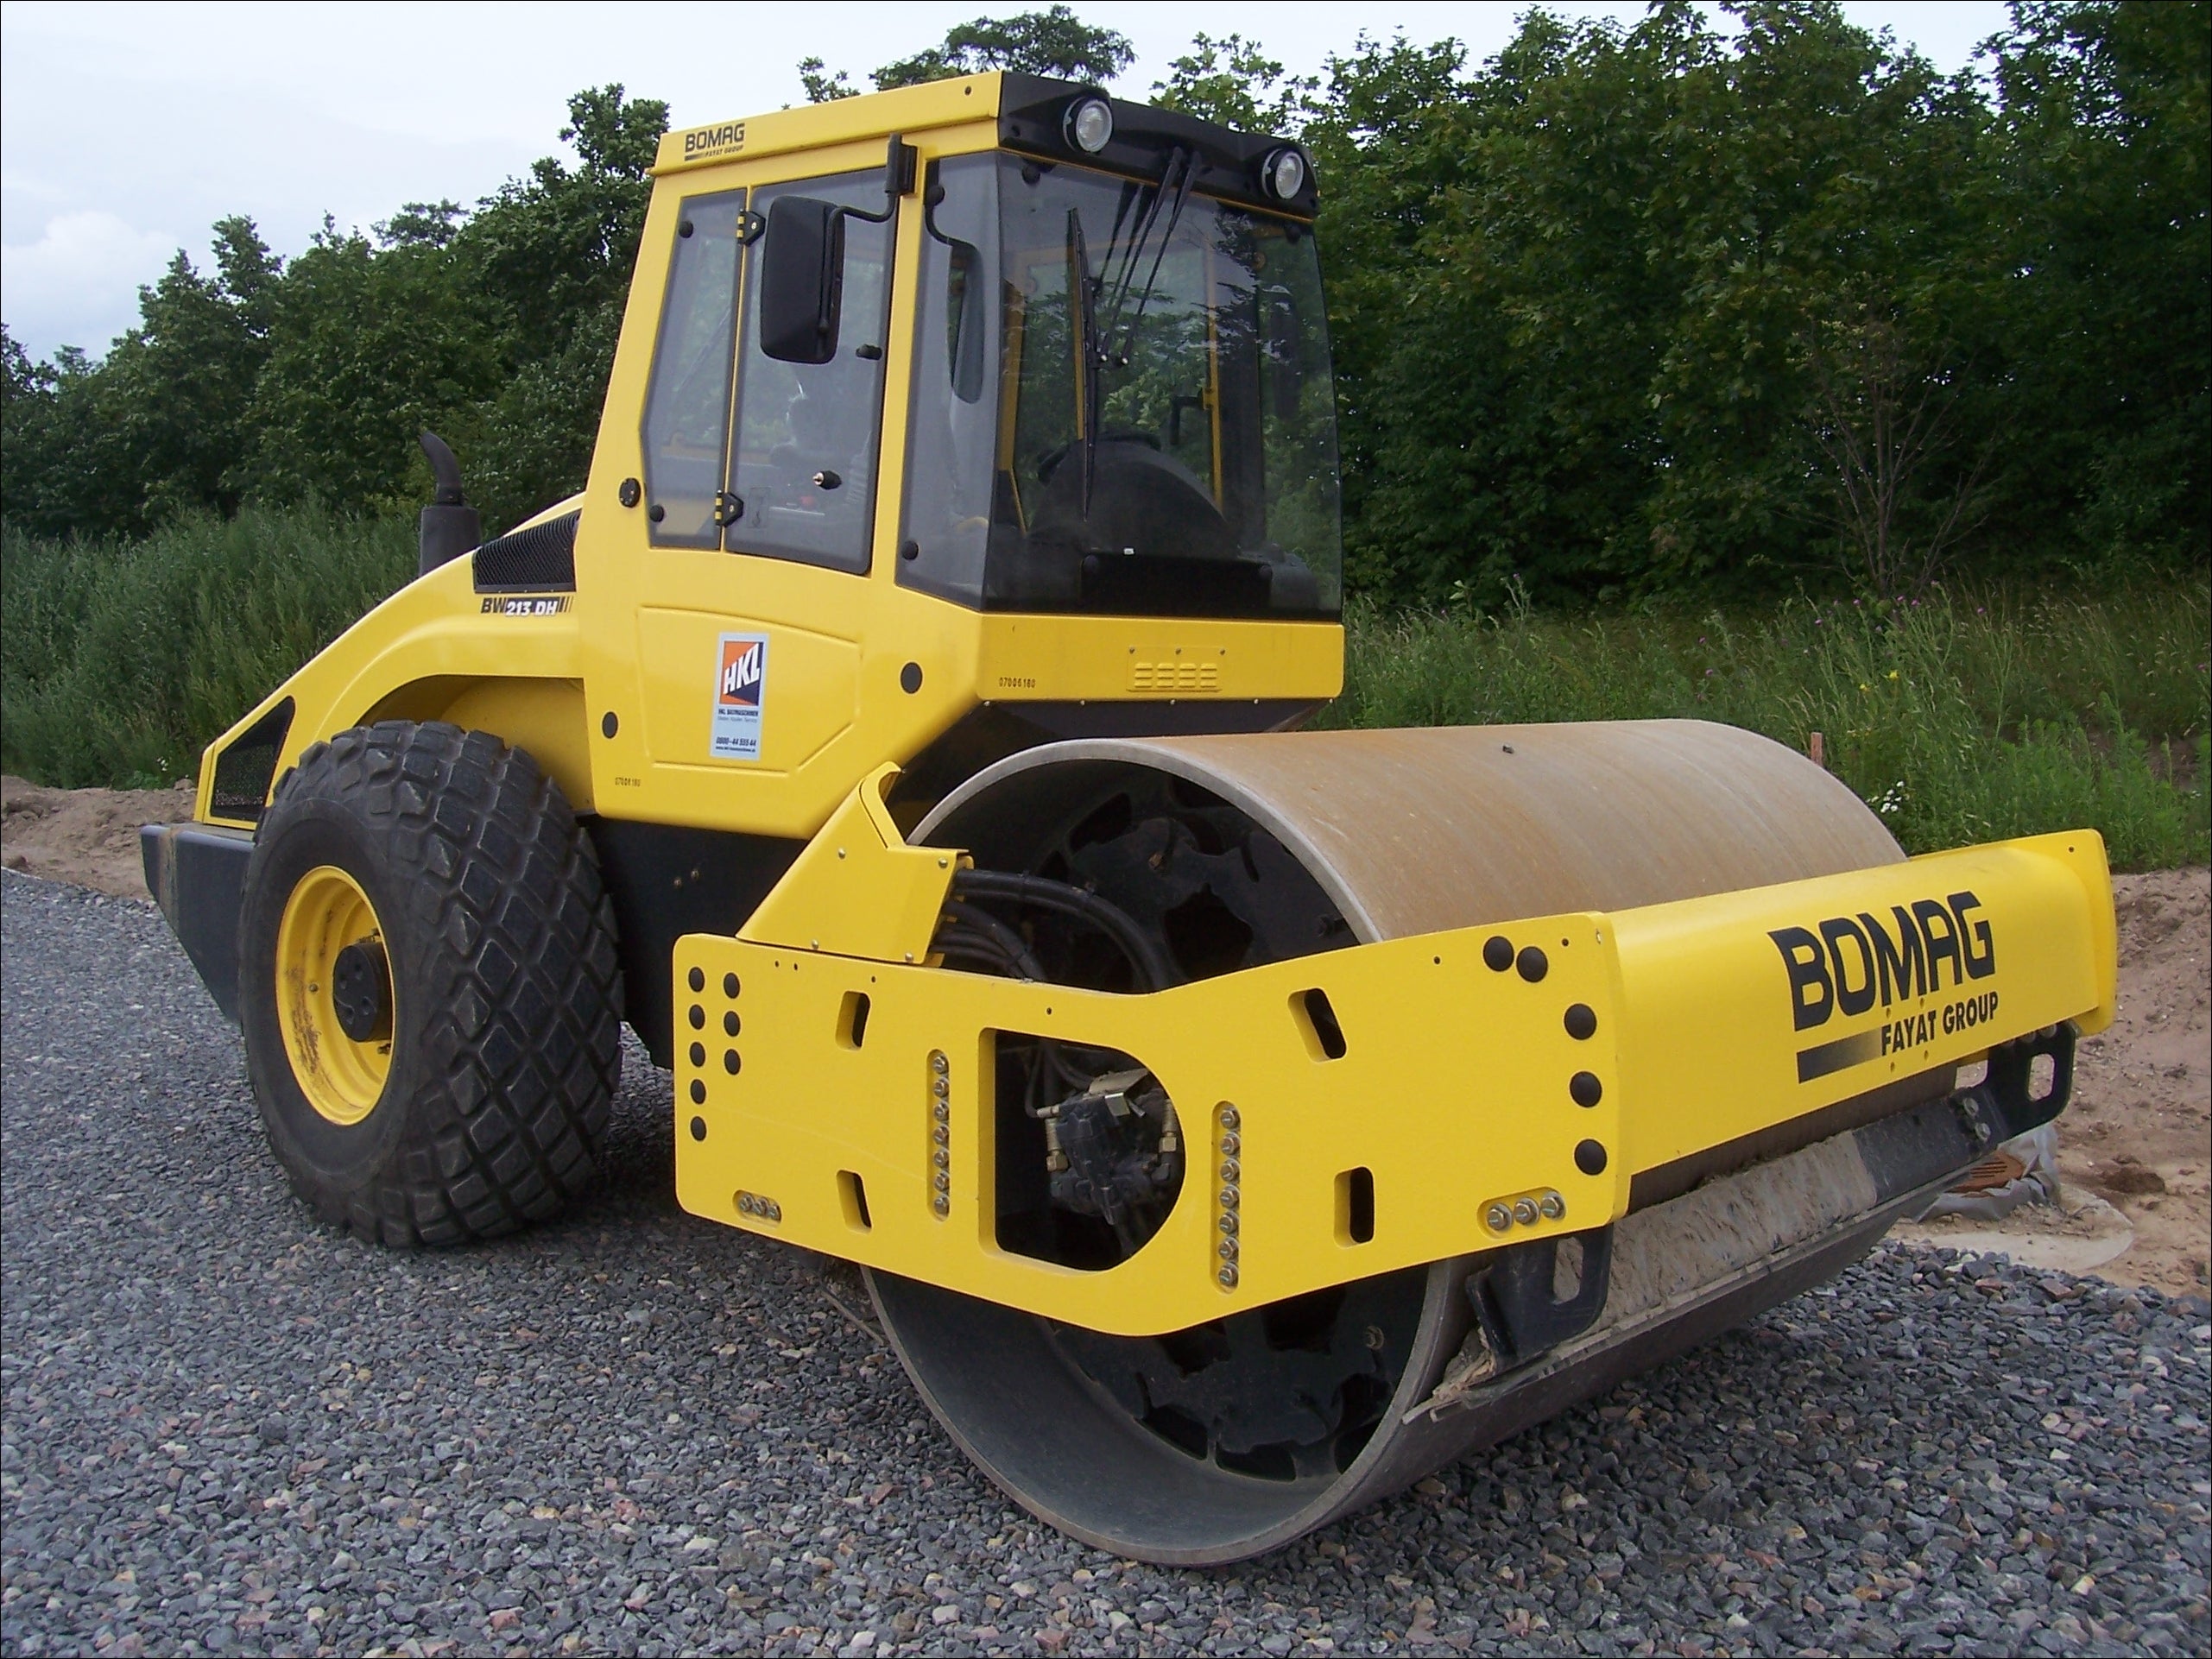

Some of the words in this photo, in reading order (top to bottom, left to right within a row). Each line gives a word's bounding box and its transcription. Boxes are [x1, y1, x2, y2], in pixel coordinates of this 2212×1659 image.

[685, 123, 745, 153] BOMAG
[533, 600, 559, 616] DH
[723, 642, 761, 695] HKL
[1766, 890, 1996, 1031] BOMAG
[1881, 1009, 1937, 1057] FAYAT
[1943, 991, 1999, 1035] GROUP
